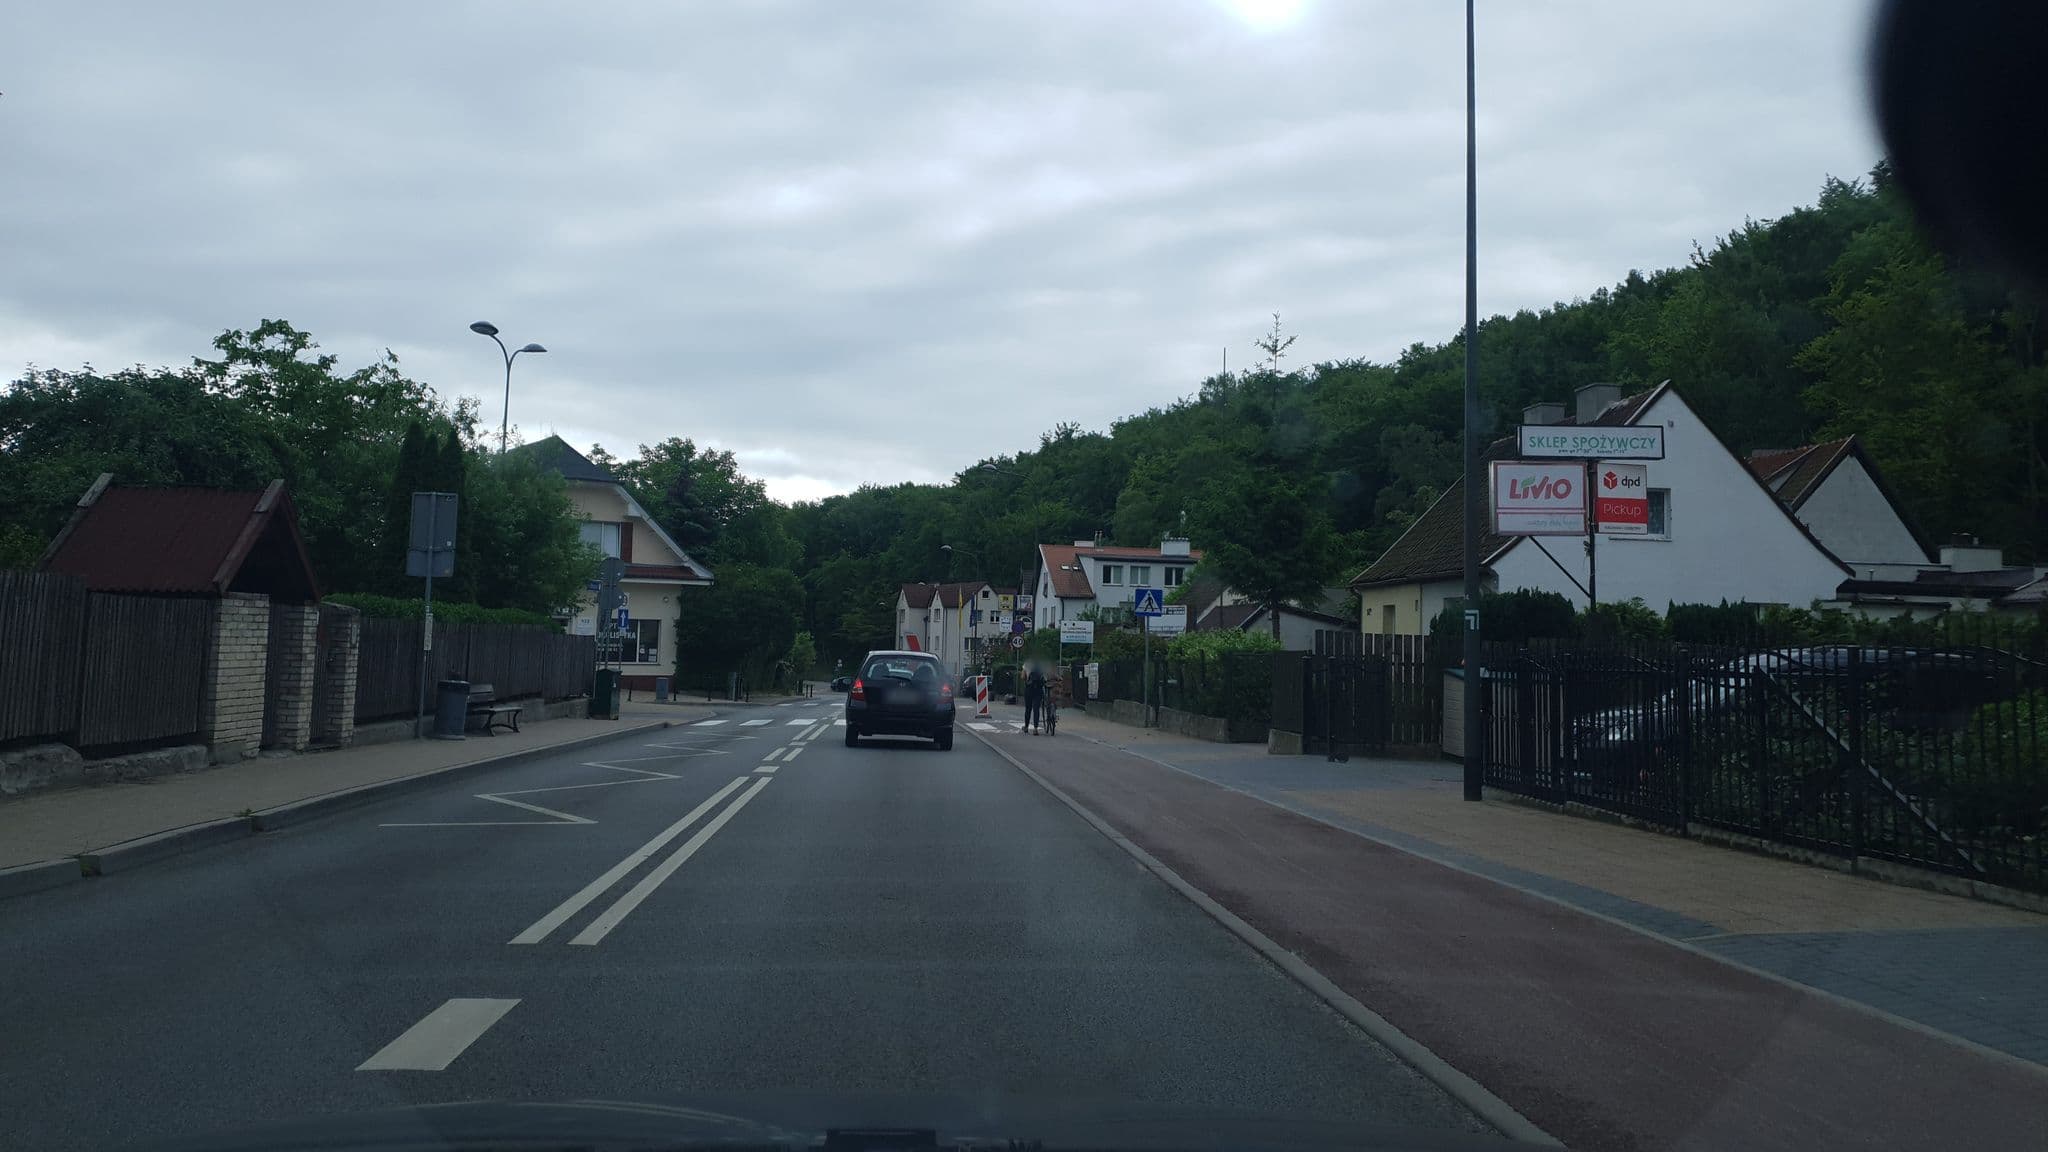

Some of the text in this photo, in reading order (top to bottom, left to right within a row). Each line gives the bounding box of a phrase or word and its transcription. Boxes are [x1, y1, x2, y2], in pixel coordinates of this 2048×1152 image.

[1529, 434, 1656, 449] SKLEP SPOŻYWCZY
[1621, 475, 1641, 489] dpd
[1603, 503, 1642, 517] Pickup
